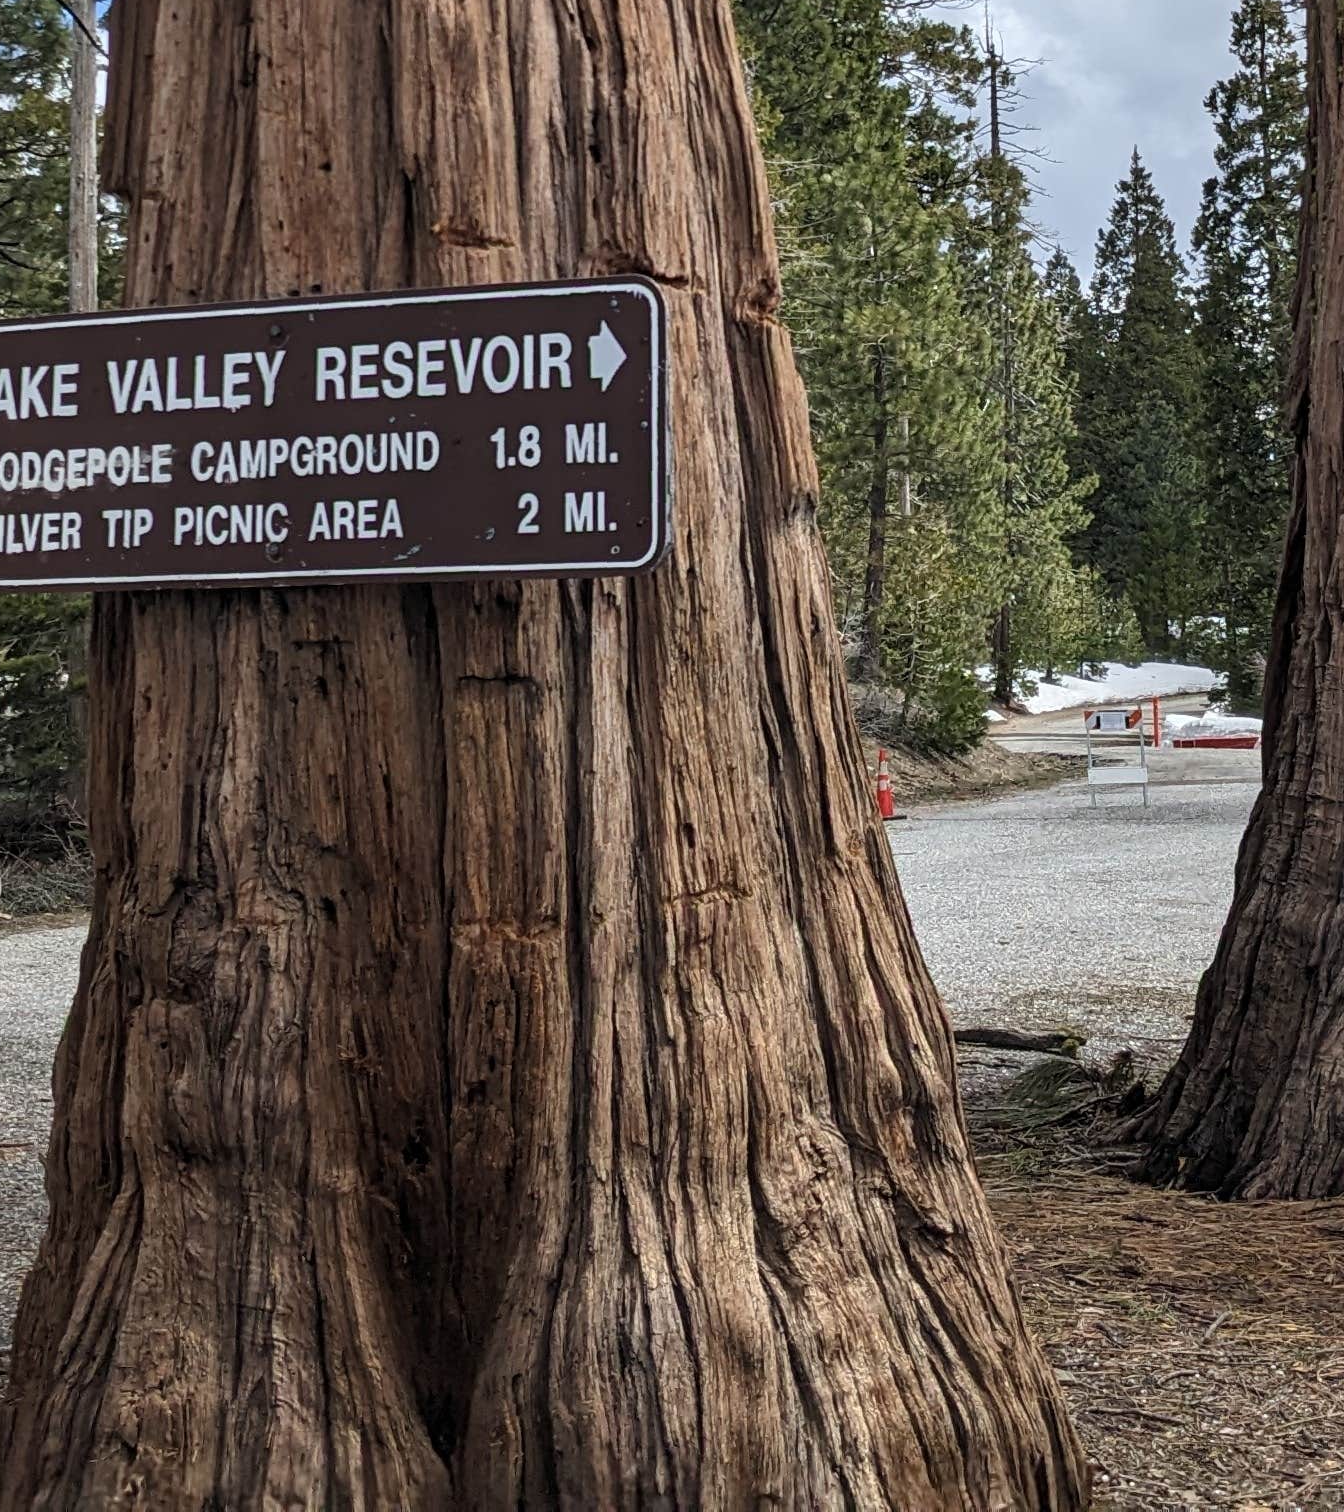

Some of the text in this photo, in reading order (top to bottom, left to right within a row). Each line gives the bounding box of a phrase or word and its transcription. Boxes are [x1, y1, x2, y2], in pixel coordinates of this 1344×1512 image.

[107, 350, 287, 413] VALLEY
[315, 332, 573, 402] RESEVOIR
[191, 430, 440, 484] CAMPGROUND
[490, 425, 542, 470] 1.8
[565, 422, 619, 465] MI.
[102, 508, 153, 549] TIP
[173, 502, 289, 547] PICNIC
[308, 497, 404, 542] AREA
[517, 492, 540, 535] 2
[564, 491, 619, 533] MI.
